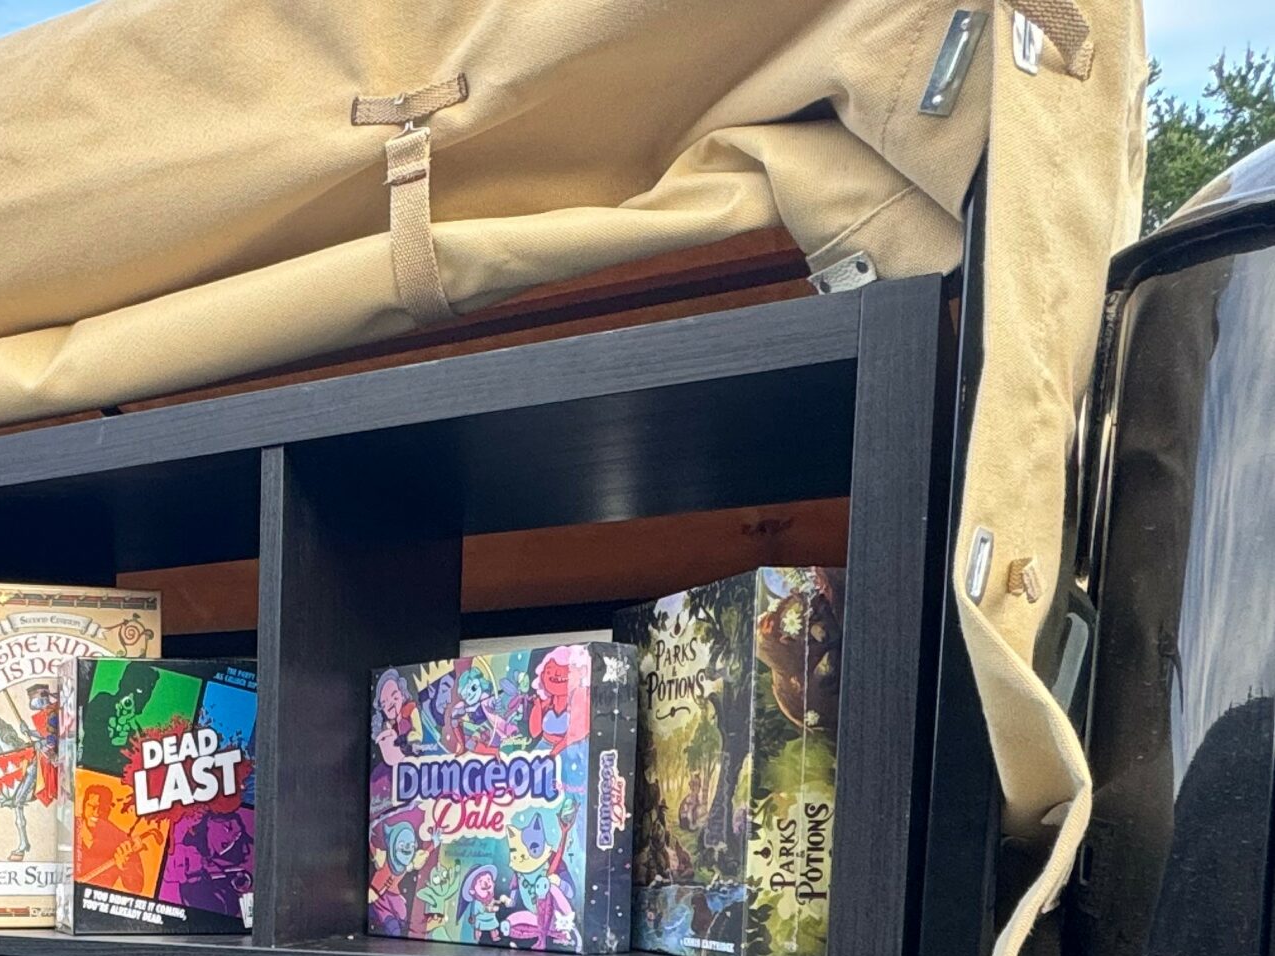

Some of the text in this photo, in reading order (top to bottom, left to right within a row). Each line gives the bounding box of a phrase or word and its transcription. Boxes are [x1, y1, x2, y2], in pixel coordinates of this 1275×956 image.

[0, 659, 24, 683] IS
[654, 636, 698, 671] PARKS
[645, 669, 706, 709] POTIONS
[142, 728, 218, 770] DEAD
[134, 749, 242, 816] LAST
[434, 787, 513, 834] Dale
[770, 818, 797, 892] PARKS
[796, 802, 833, 905] POTIONS
[83, 898, 164, 925] YOU'RE ALREADY DEAD.
[93, 889, 109, 902] YOU
[135, 899, 147, 910] SEE
[147, 901, 156, 912] IT
